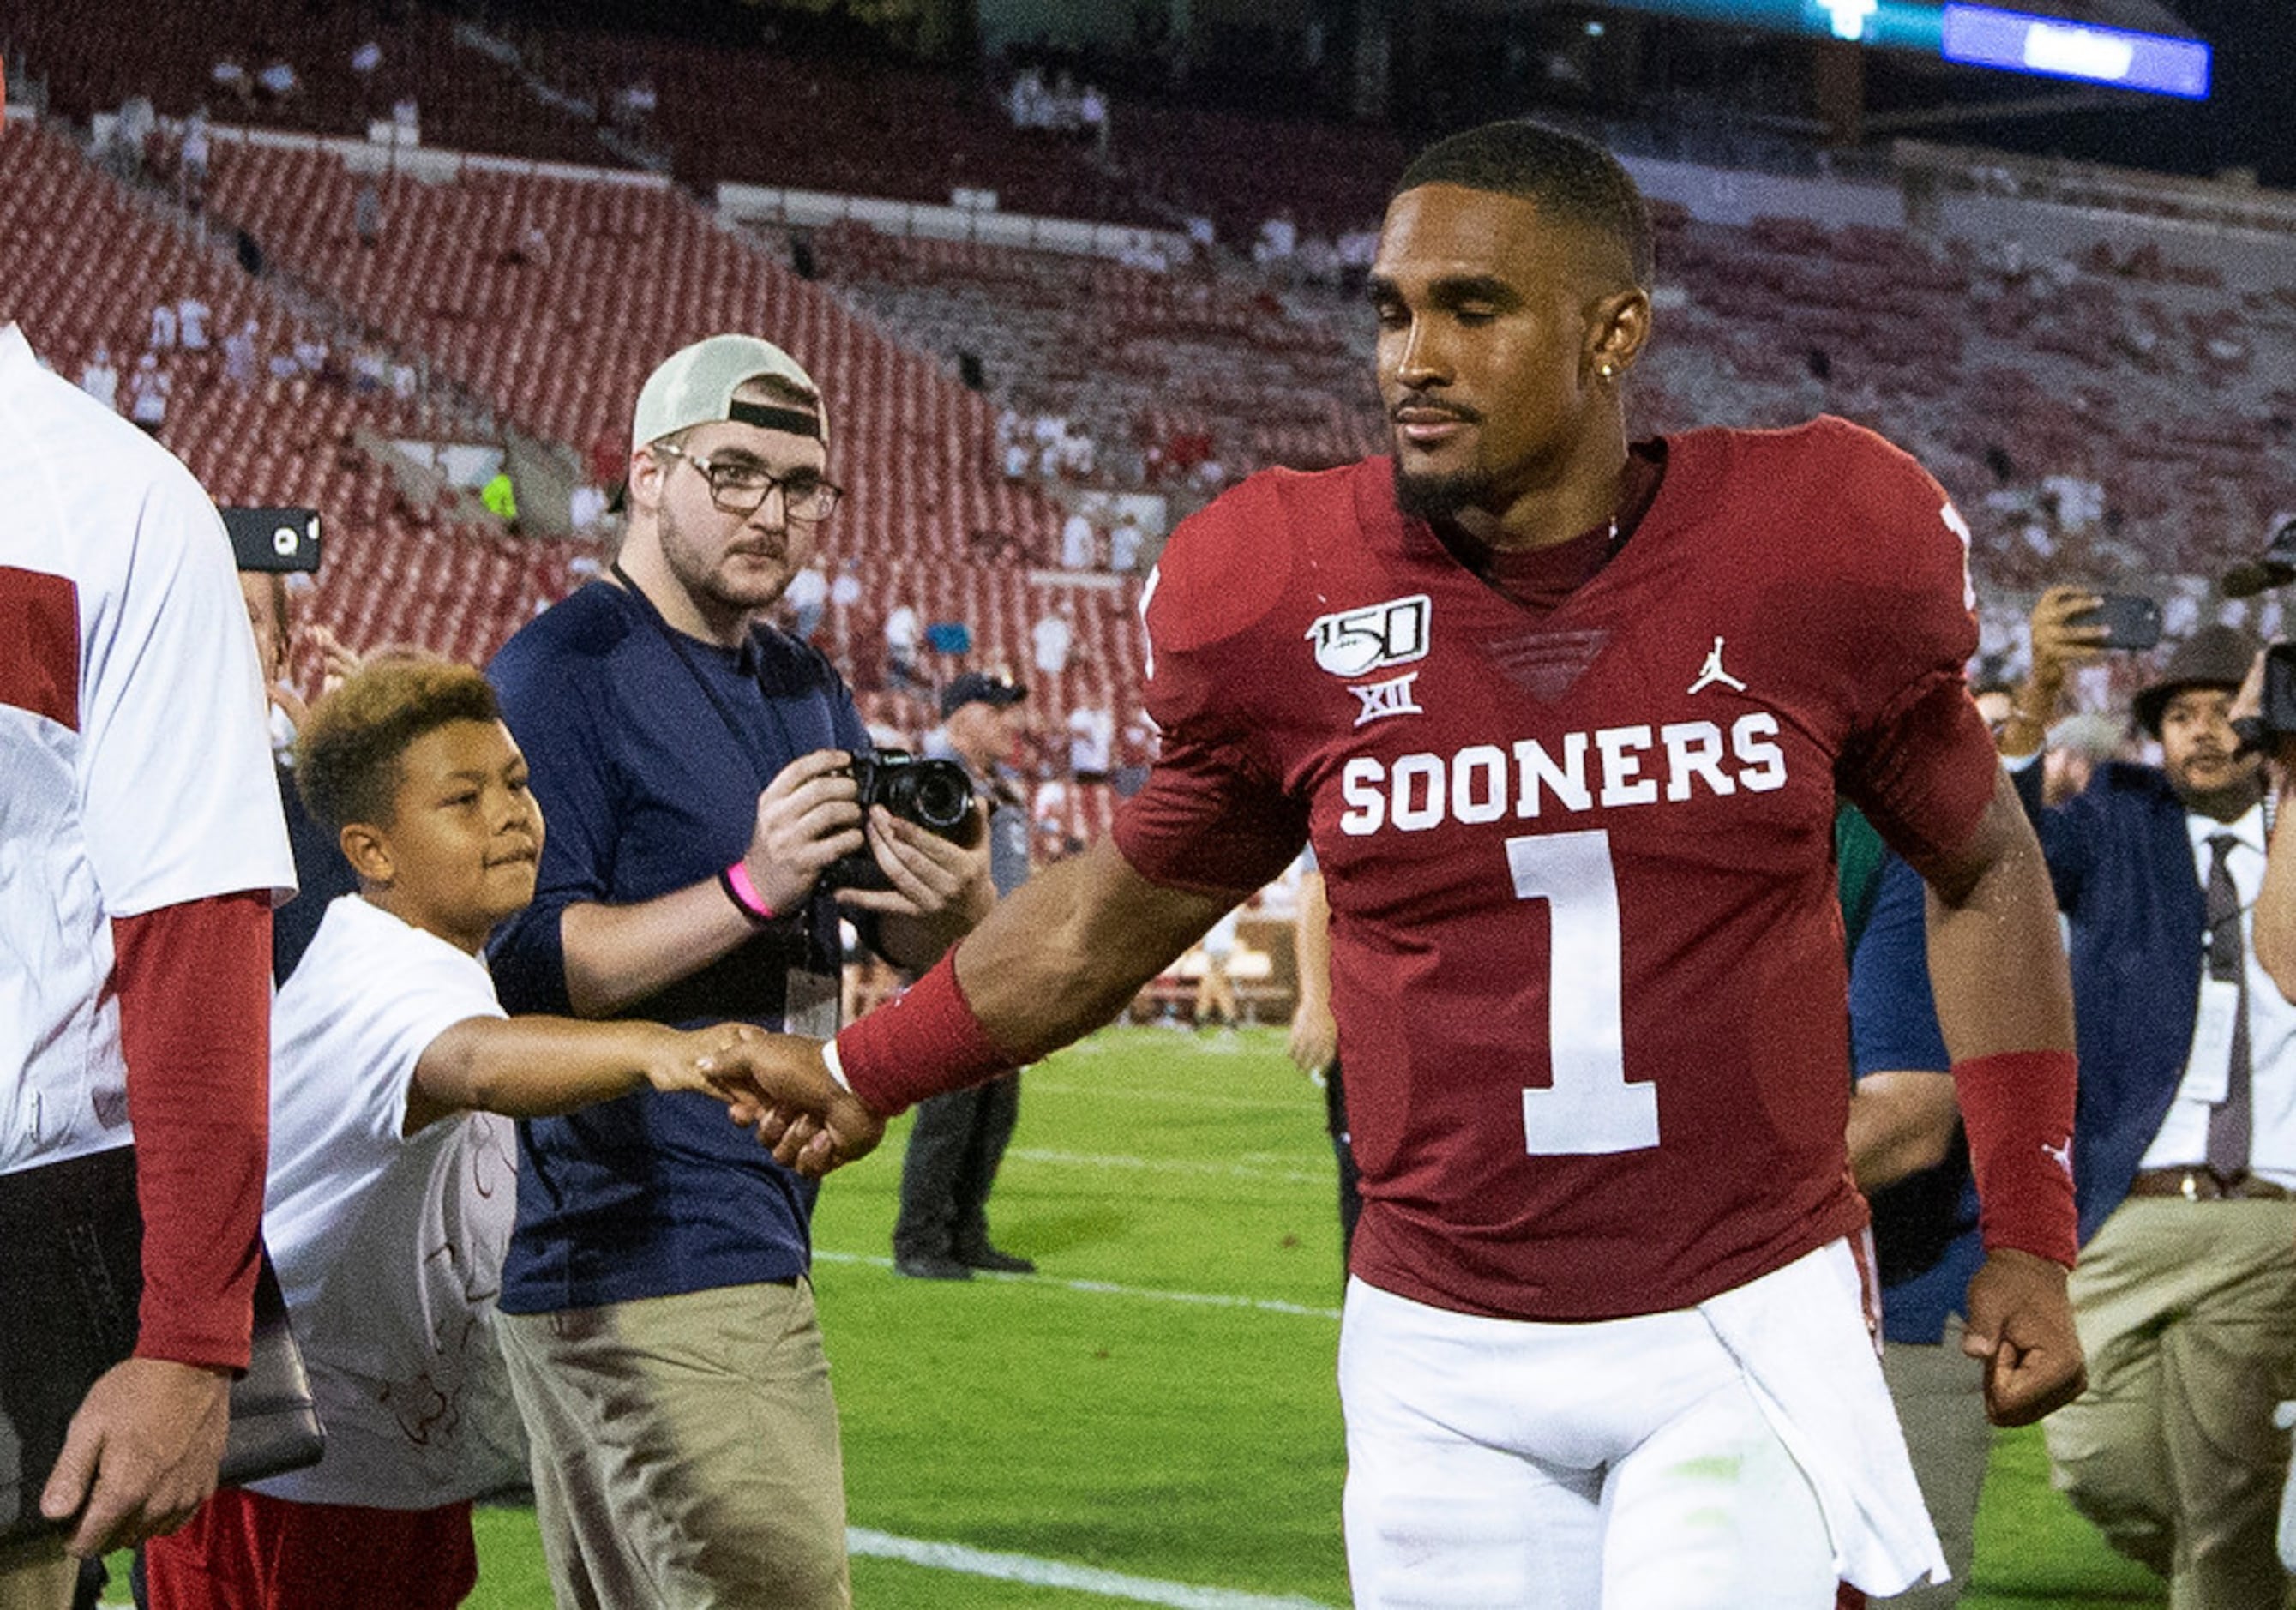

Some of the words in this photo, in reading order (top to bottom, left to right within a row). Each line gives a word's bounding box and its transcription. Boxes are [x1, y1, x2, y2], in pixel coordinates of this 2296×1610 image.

[1307, 595, 1430, 676] 150
[1348, 671, 1423, 726] XII
[1340, 712, 1788, 835] SOONERS
[1506, 830, 1660, 1156] 1
